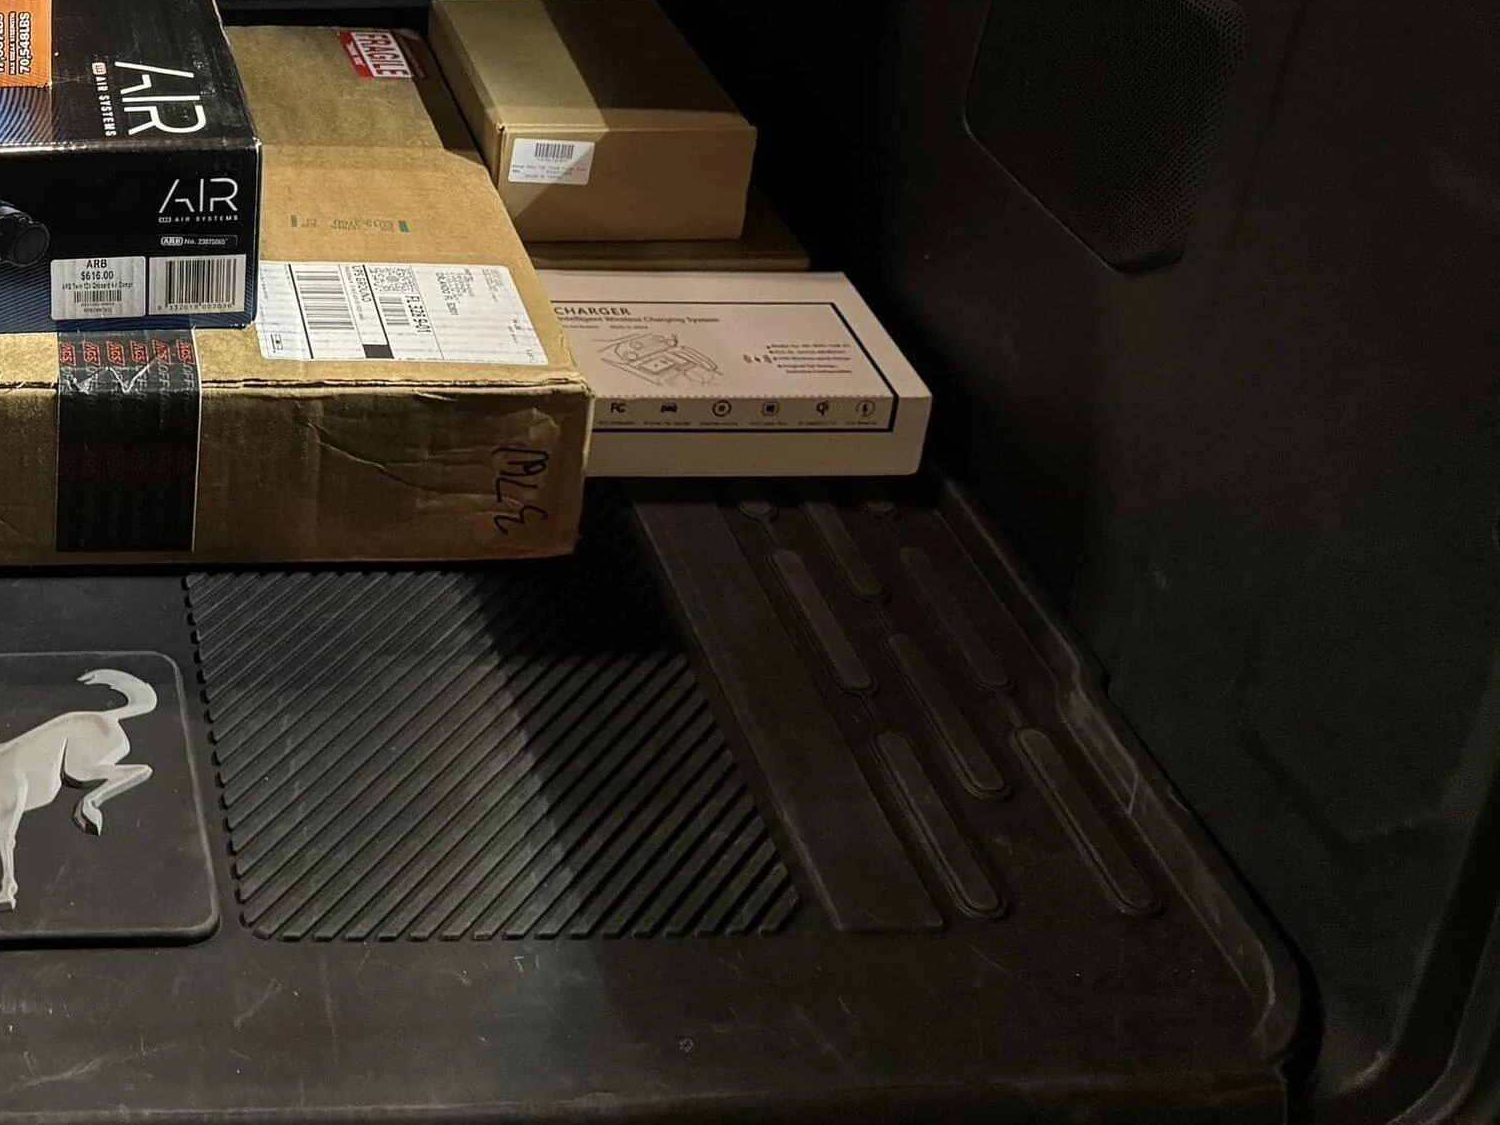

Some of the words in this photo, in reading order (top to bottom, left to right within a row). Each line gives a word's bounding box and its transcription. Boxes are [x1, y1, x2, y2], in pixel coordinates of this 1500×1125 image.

[356, 33, 409, 75] FRAGILE
[96, 76, 108, 92] AIR
[114, 61, 207, 136] AIR
[98, 95, 117, 136] SYSTEMS
[158, 177, 239, 214] AIR
[162, 237, 183, 246] ARB
[86, 259, 107, 269] ARB
[352, 265, 364, 276] UPS
[80, 271, 114, 281] $616.00
[436, 272, 450, 294] ORLANDO
[355, 277, 371, 303] GROUND
[405, 295, 420, 303] FL
[553, 306, 631, 315] CHARGER
[644, 316, 684, 324] Charging
